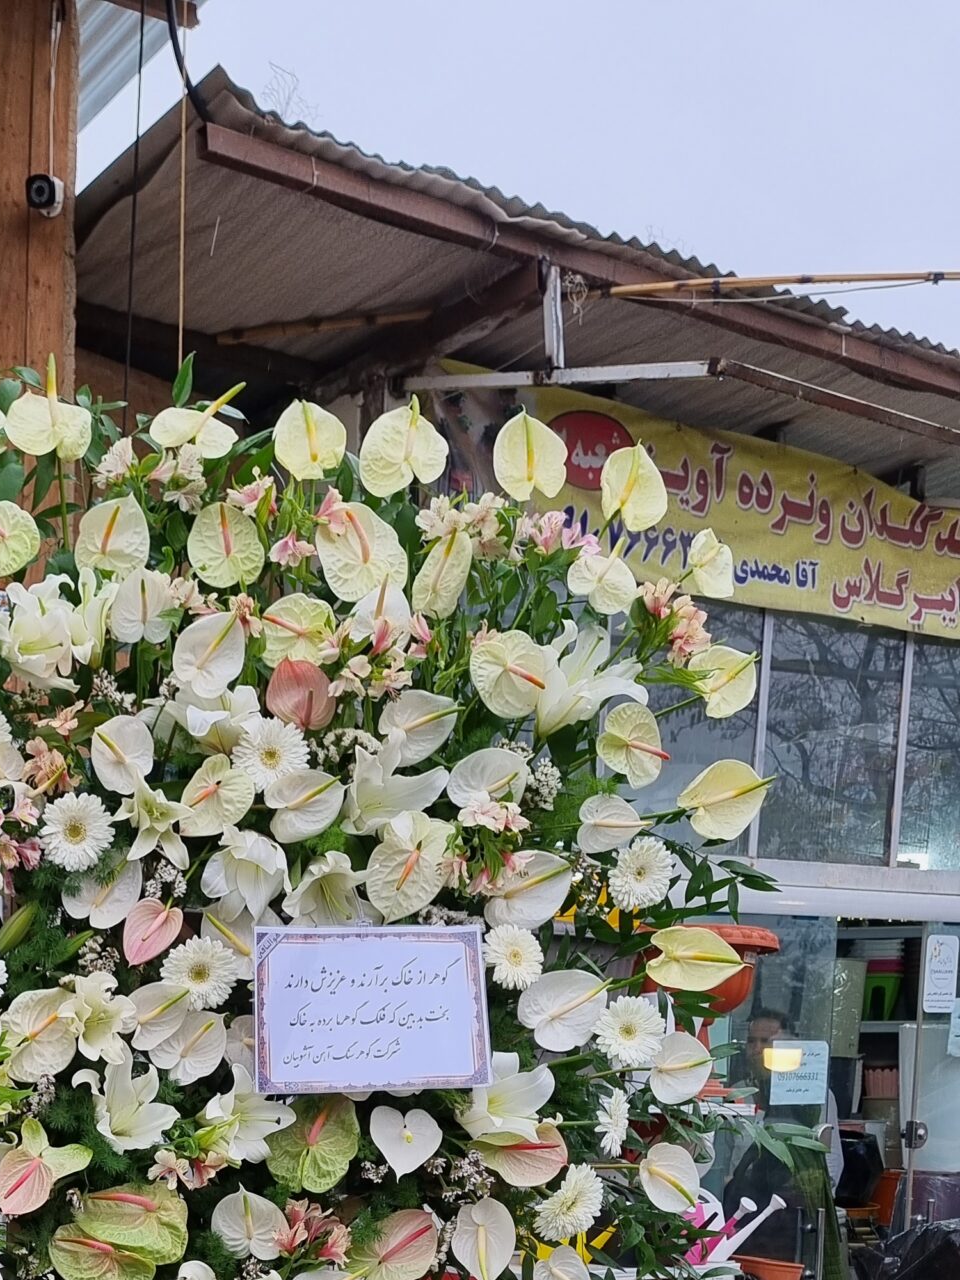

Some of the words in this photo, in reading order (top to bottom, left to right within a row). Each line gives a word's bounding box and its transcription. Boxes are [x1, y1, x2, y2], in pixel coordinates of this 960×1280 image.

[840, 486, 944, 549] گلدان
[734, 558, 791, 585] محمدی
[795, 559, 819, 589] آقا
[832, 557, 909, 613] گلاس
[283, 973, 309, 990] دارند
[311, 965, 347, 995] عزیزش
[349, 978, 356, 988] و
[391, 956, 418, 987] خاک
[416, 969, 427, 986] از
[428, 956, 463, 986] گوهر
[289, 1001, 312, 1026] خاک
[317, 1016, 333, 1031] برده
[360, 1001, 391, 1025] فلک
[388, 1000, 407, 1024] که
[425, 1005, 450, 1023] بخت
[309, 1020, 316, 1032] به
[311, 1044, 334, 1064] آهن
[332, 1040, 359, 1060] سنگ
[355, 1036, 381, 1060] گوهر
[373, 1035, 401, 1060] شرکت
